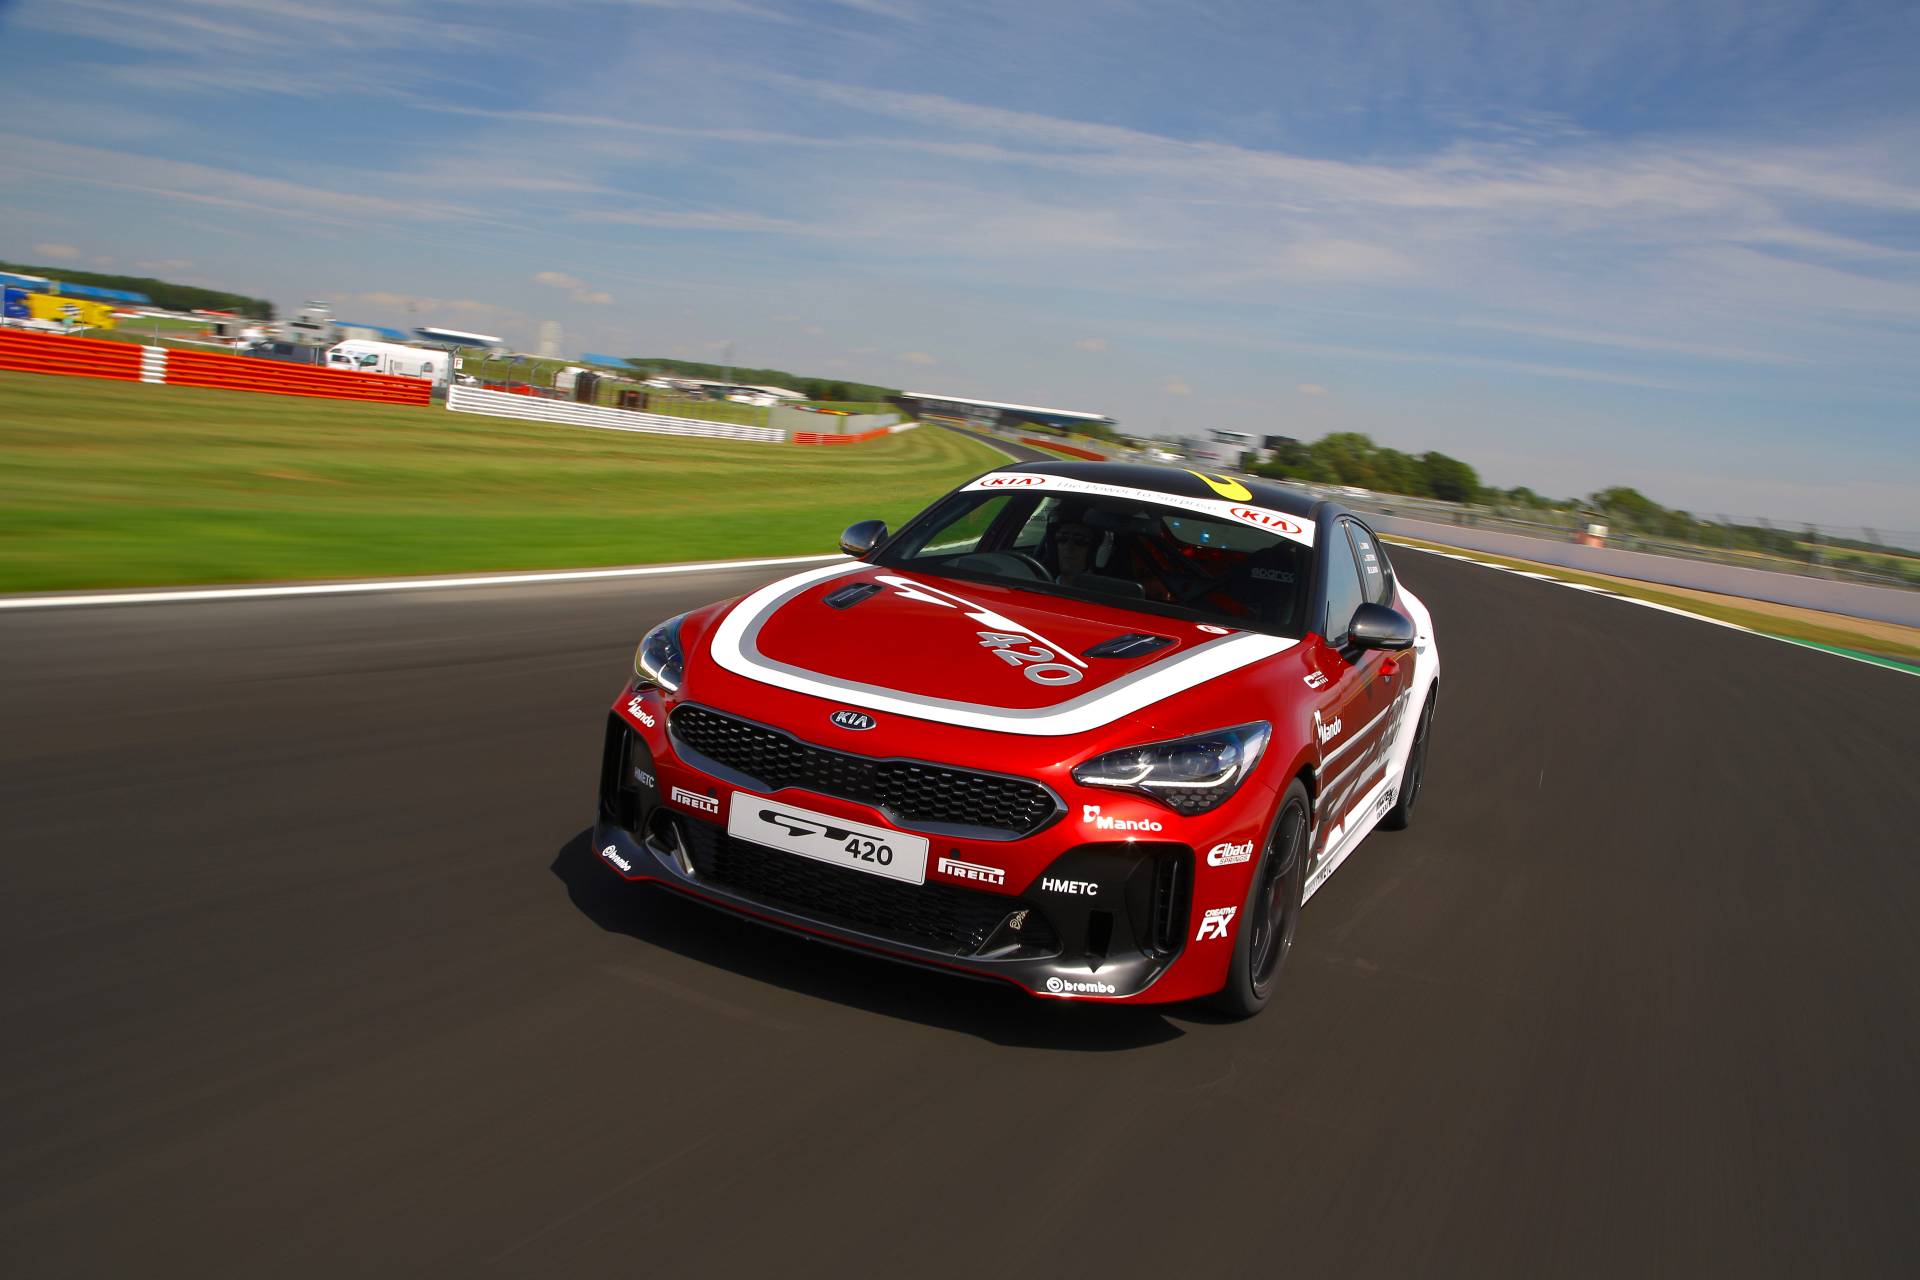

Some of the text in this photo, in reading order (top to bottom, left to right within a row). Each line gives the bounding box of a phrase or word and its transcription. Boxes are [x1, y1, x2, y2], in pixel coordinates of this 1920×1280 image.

[989, 477, 1033, 486] KIA
[1085, 483, 1129, 495] Power
[1240, 509, 1291, 532] KIA
[976, 631, 1084, 686] 420
[628, 702, 655, 728] Mando
[834, 711, 870, 729] KIA
[1321, 716, 1342, 746] Mando
[671, 785, 719, 814] PIRELLI
[1096, 816, 1163, 832] Mando
[611, 847, 632, 873] brembo
[844, 838, 893, 867] 420
[1207, 840, 1254, 867] Eibach
[937, 857, 1005, 885] PIRELLI
[1041, 877, 1099, 896] HMETC
[1205, 905, 1238, 918] CREATIVE
[1195, 912, 1235, 942] FX
[1063, 979, 1116, 994] brembo
